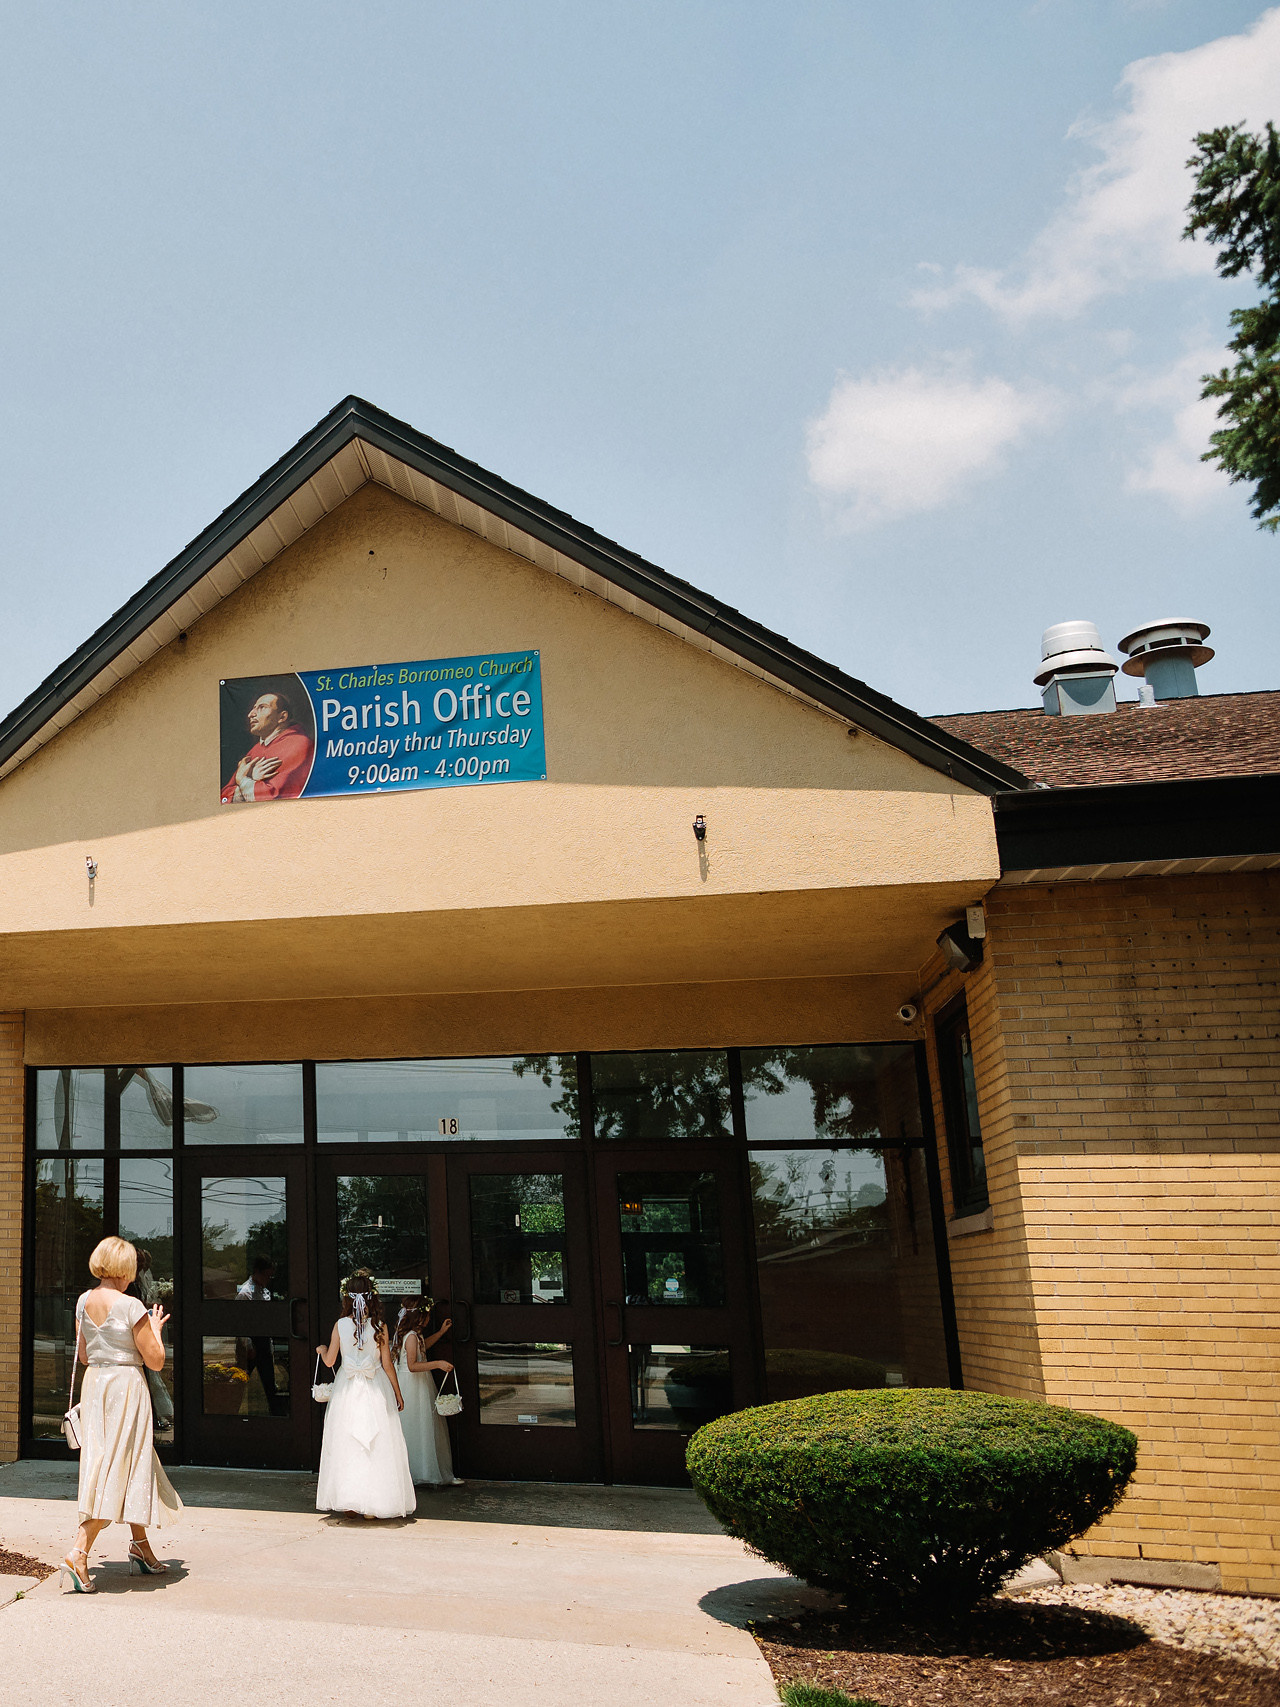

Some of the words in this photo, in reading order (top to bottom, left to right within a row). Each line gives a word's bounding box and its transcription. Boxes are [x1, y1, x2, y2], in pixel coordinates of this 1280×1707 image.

[316, 676, 334, 692] St.
[338, 670, 395, 690] Charles
[398, 665, 474, 684] Borromeo
[479, 656, 533, 677] Church
[322, 690, 421, 732] Parish
[433, 683, 531, 723] Office
[326, 734, 400, 759] Monday
[404, 731, 442, 752] thru
[447, 723, 532, 749] Thursday
[348, 763, 419, 785] 9:00am
[434, 756, 510, 781] 4:00pm
[441, 1118, 457, 1134] 18
